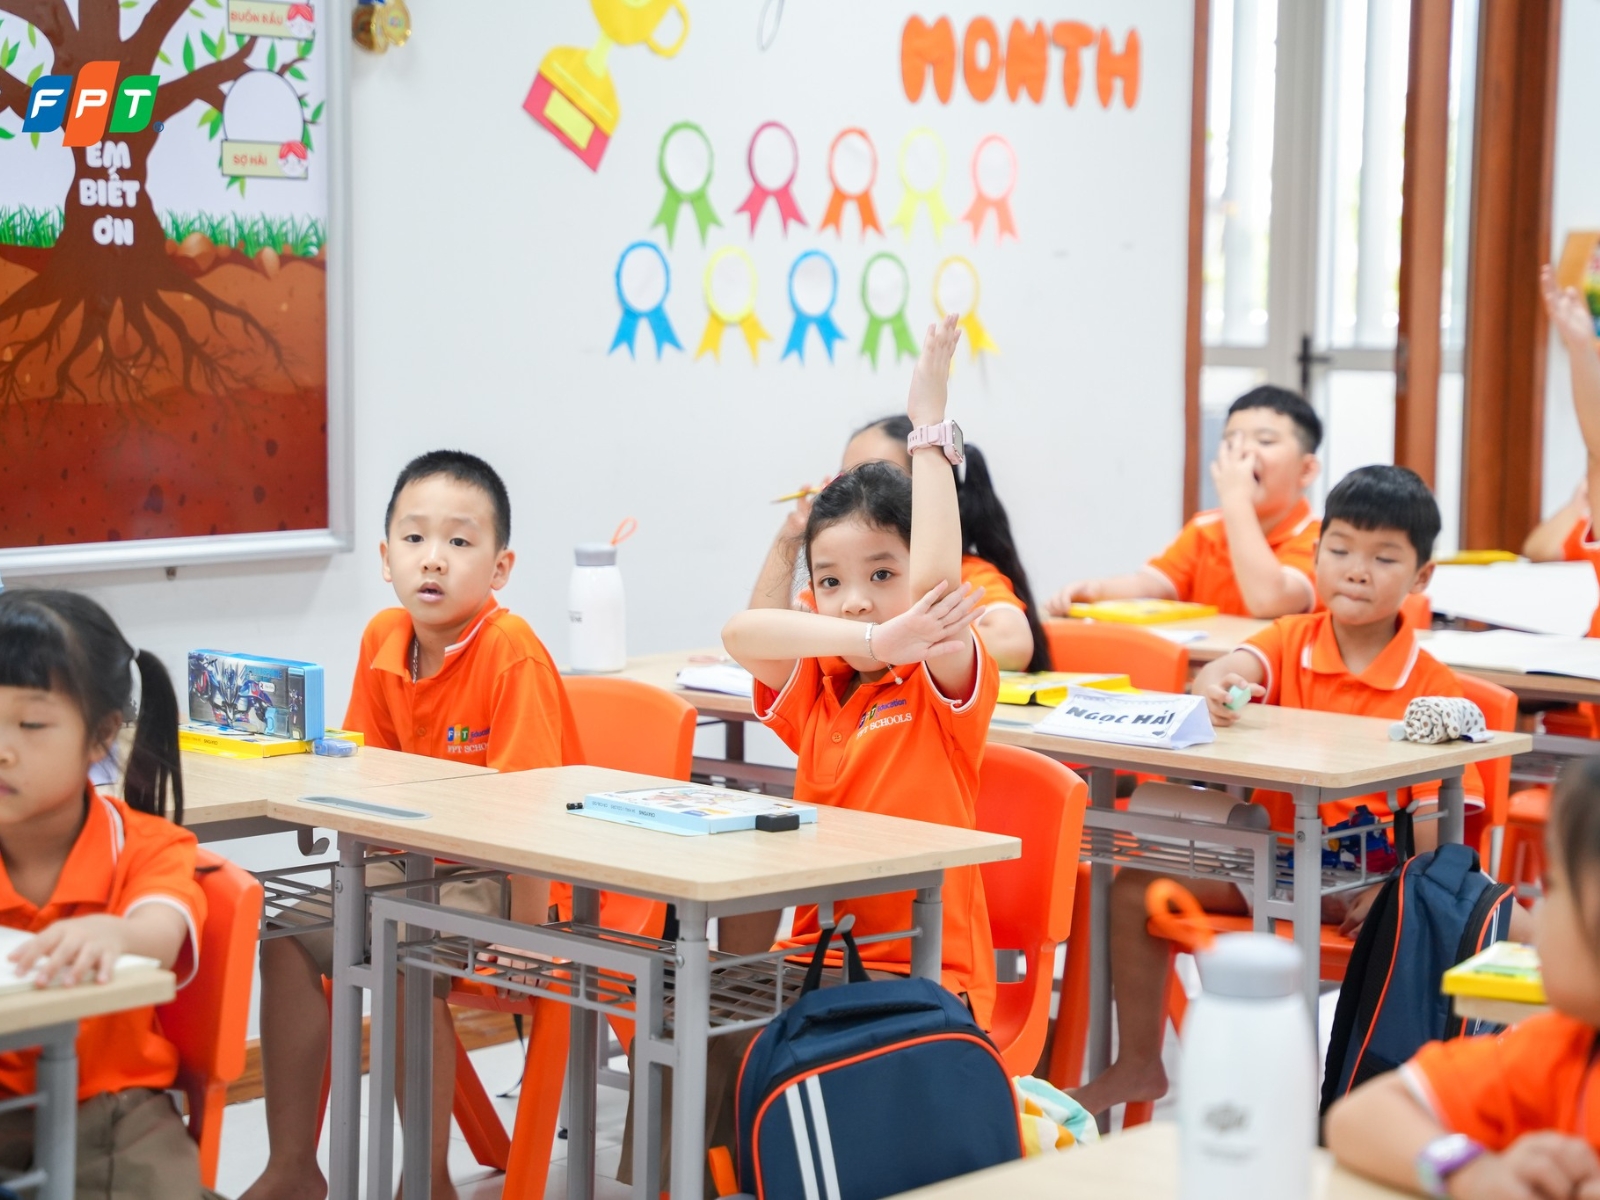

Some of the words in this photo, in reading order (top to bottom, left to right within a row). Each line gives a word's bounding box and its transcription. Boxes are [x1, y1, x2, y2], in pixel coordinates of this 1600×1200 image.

[901, 14, 1140, 109] MONTH
[85, 139, 132, 169] EM
[79, 166, 141, 208] BIẾT
[93, 214, 135, 247] ƠN
[869, 712, 913, 731] SCHOOLS
[1065, 706, 1130, 725] NGỌC
[448, 745, 461, 753] FPT
